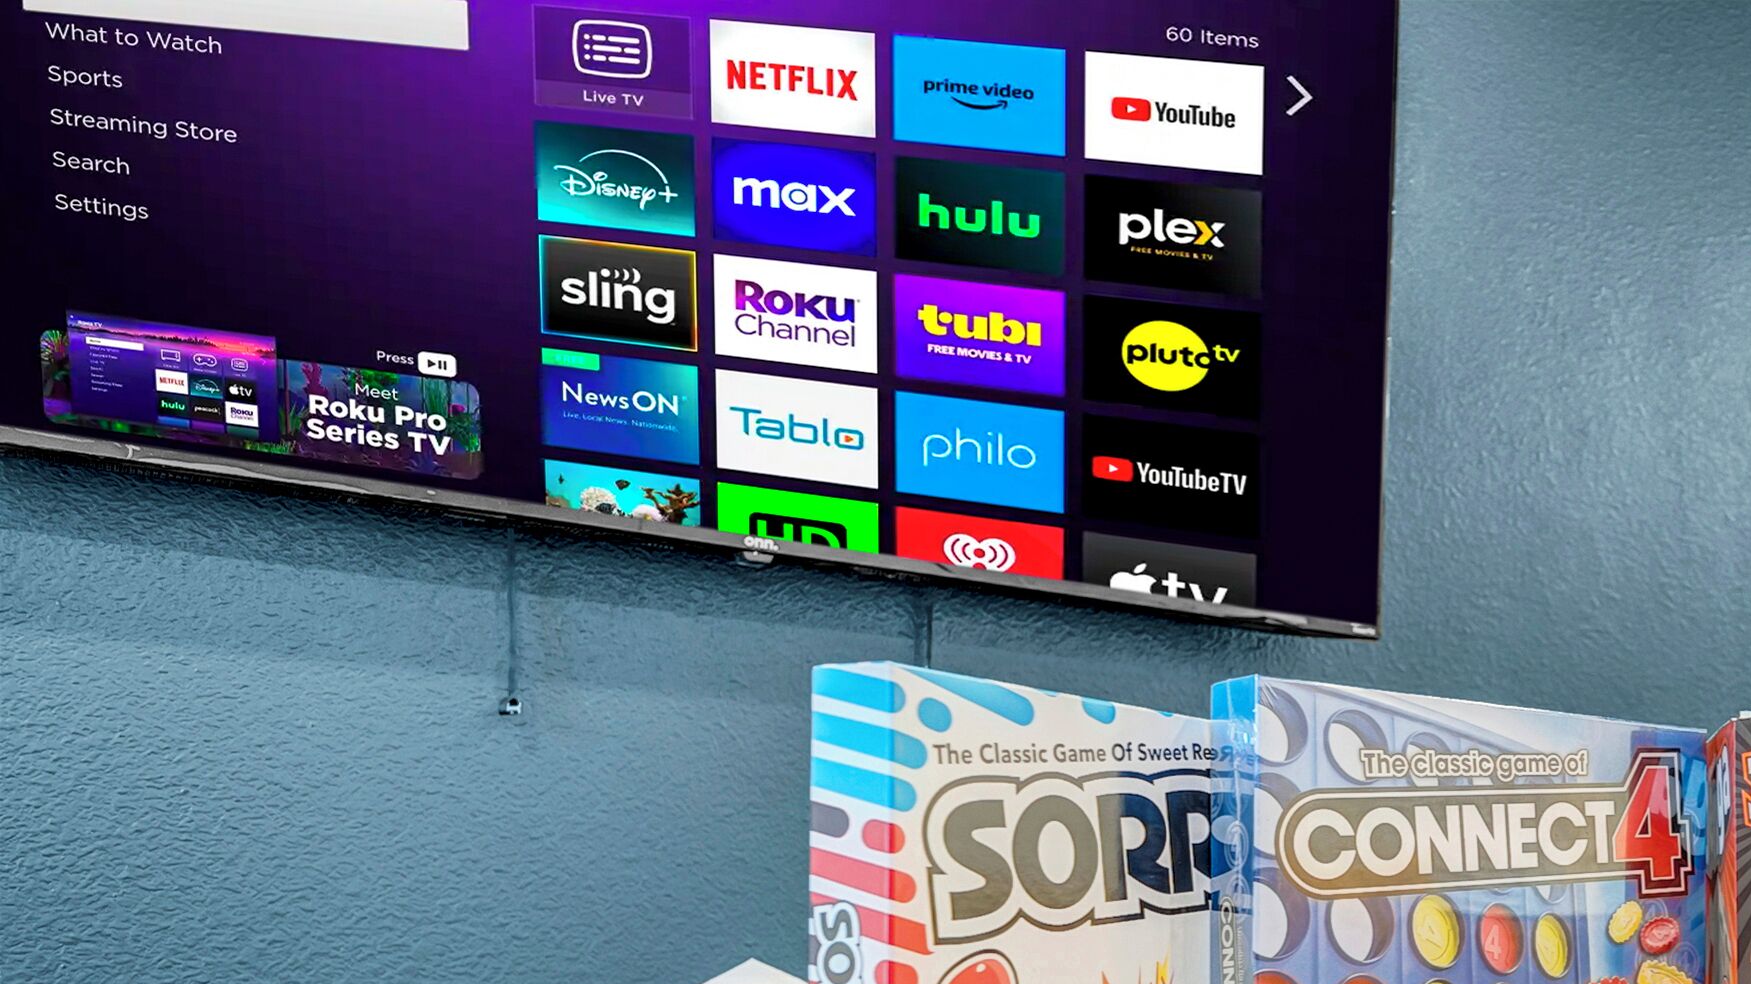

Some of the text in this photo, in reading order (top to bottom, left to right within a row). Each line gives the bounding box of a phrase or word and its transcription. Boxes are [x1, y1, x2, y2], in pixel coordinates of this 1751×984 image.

[45, 22, 223, 55] What to Watch
[1166, 26, 1260, 49] 60 Items
[47, 65, 123, 89] Sports
[727, 59, 858, 101] NETFLIX
[923, 77, 1034, 101] prime video
[583, 90, 645, 107] Live TV
[49, 108, 238, 143] Streaming Store
[1155, 101, 1236, 129] YouTube
[52, 150, 131, 176] Search
[54, 193, 149, 221] Settings
[733, 177, 857, 217] max
[918, 193, 1041, 238] hulu
[1119, 208, 1226, 249] plex
[1201, 253, 1213, 261] TV
[561, 267, 676, 325] sling
[735, 313, 856, 347] Channel
[917, 303, 1042, 347] tubi
[376, 350, 415, 365] Press
[927, 343, 1032, 364] FREE MOVIES & TV
[1126, 342, 1240, 369] pluto tv
[161, 400, 185, 411] hulu
[240, 385, 252, 397] tv
[355, 381, 398, 401] Meet
[308, 393, 447, 431] Roku Pro
[306, 418, 451, 456] Series TV
[729, 406, 865, 451] Tablo
[923, 427, 1037, 469] philo
[933, 744, 972, 764] The
[979, 743, 1048, 764] Classic
[1053, 743, 1106, 762] Game
[1112, 742, 1133, 761] Of
[1138, 744, 1188, 761] Sweet
[1361, 750, 1588, 782] The classic game of
[1293, 801, 1615, 879] CONNECT
[1612, 760, 1686, 884] 4
[944, 791, 1211, 920] SORR
